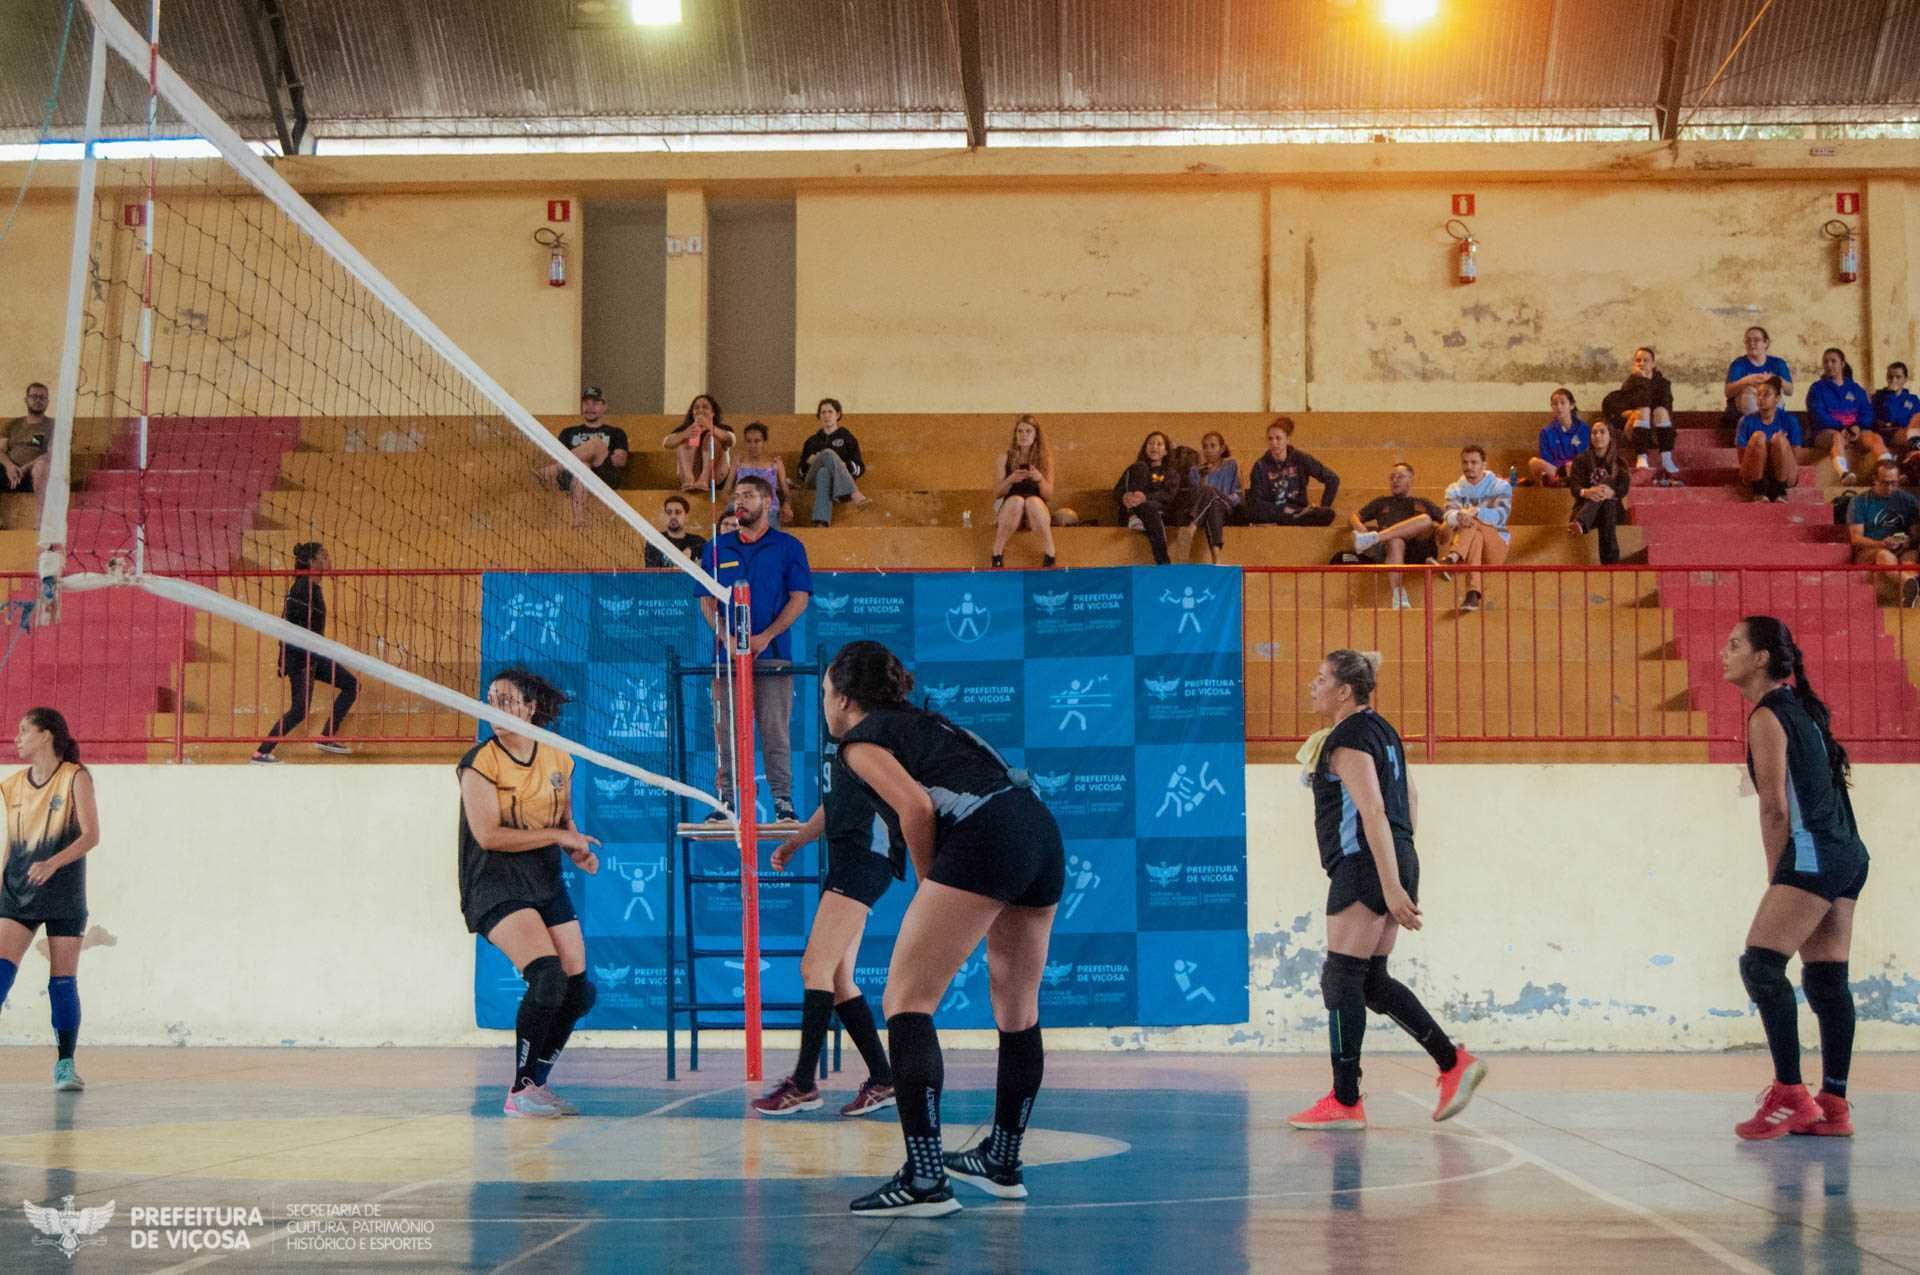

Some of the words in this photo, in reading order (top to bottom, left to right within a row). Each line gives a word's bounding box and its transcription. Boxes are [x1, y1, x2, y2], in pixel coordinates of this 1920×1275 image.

[1184, 689, 1196, 697] DE
[963, 695, 976, 703] DE
[1074, 783, 1086, 792] DE
[1186, 874, 1198, 883] DE
[1077, 974, 1089, 982] DE
